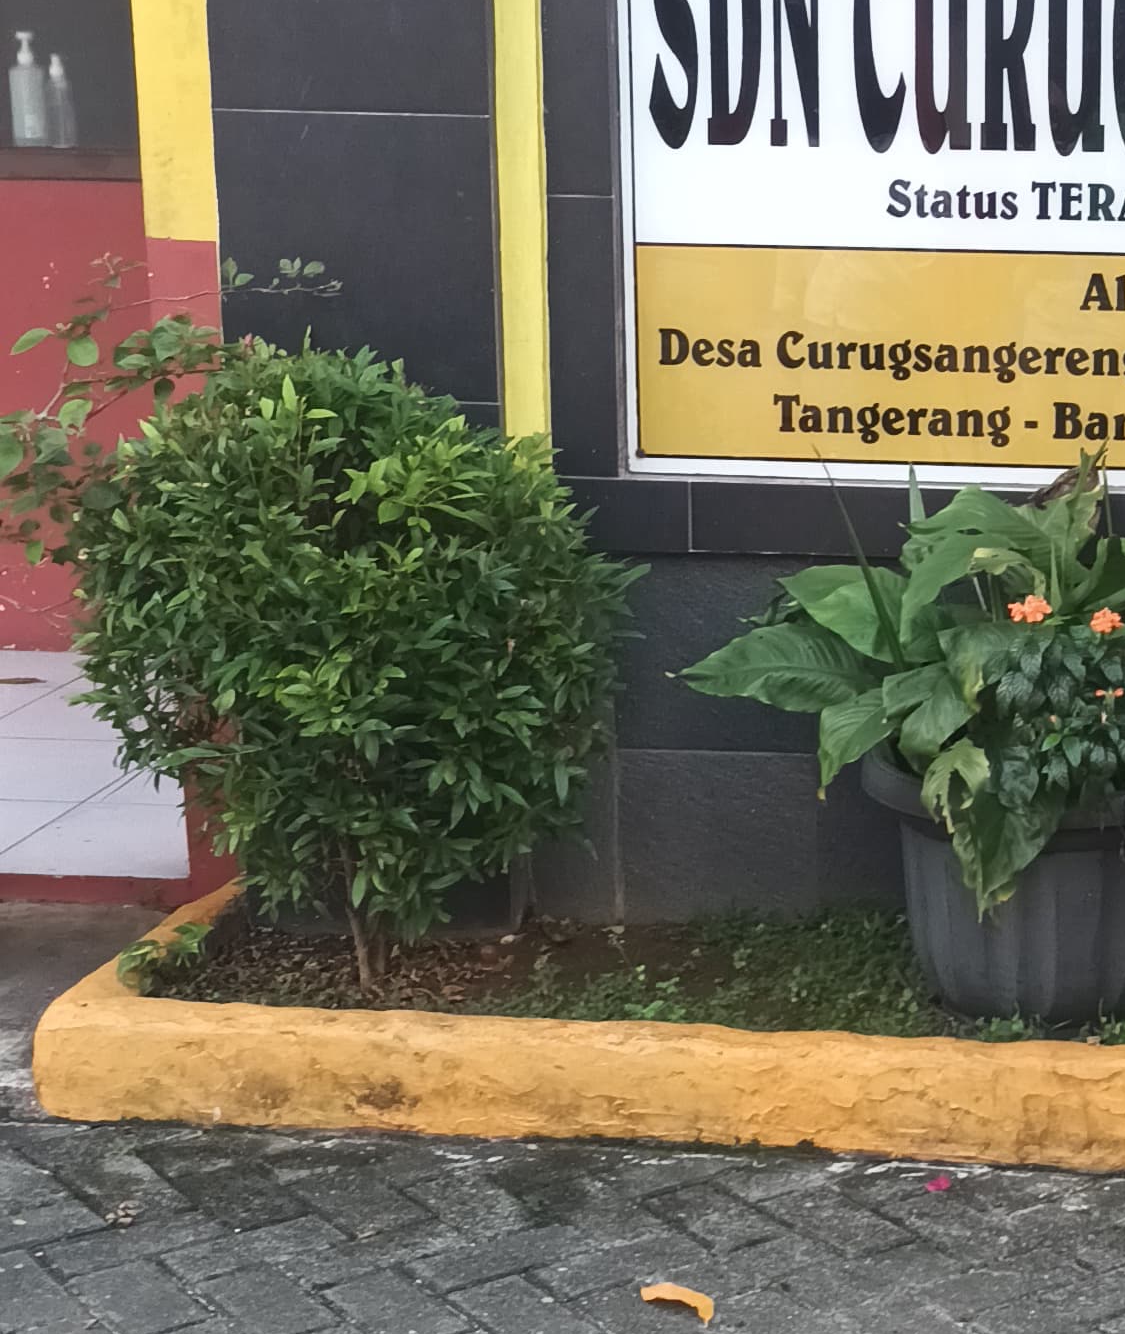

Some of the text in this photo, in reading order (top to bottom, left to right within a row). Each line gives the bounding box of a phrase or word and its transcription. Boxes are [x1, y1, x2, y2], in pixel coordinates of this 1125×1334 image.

[886, 179, 1018, 220] Status
[658, 328, 762, 368] Desa
[773, 393, 1011, 448] Tangerang
[1024, 420, 1038, 429] -
